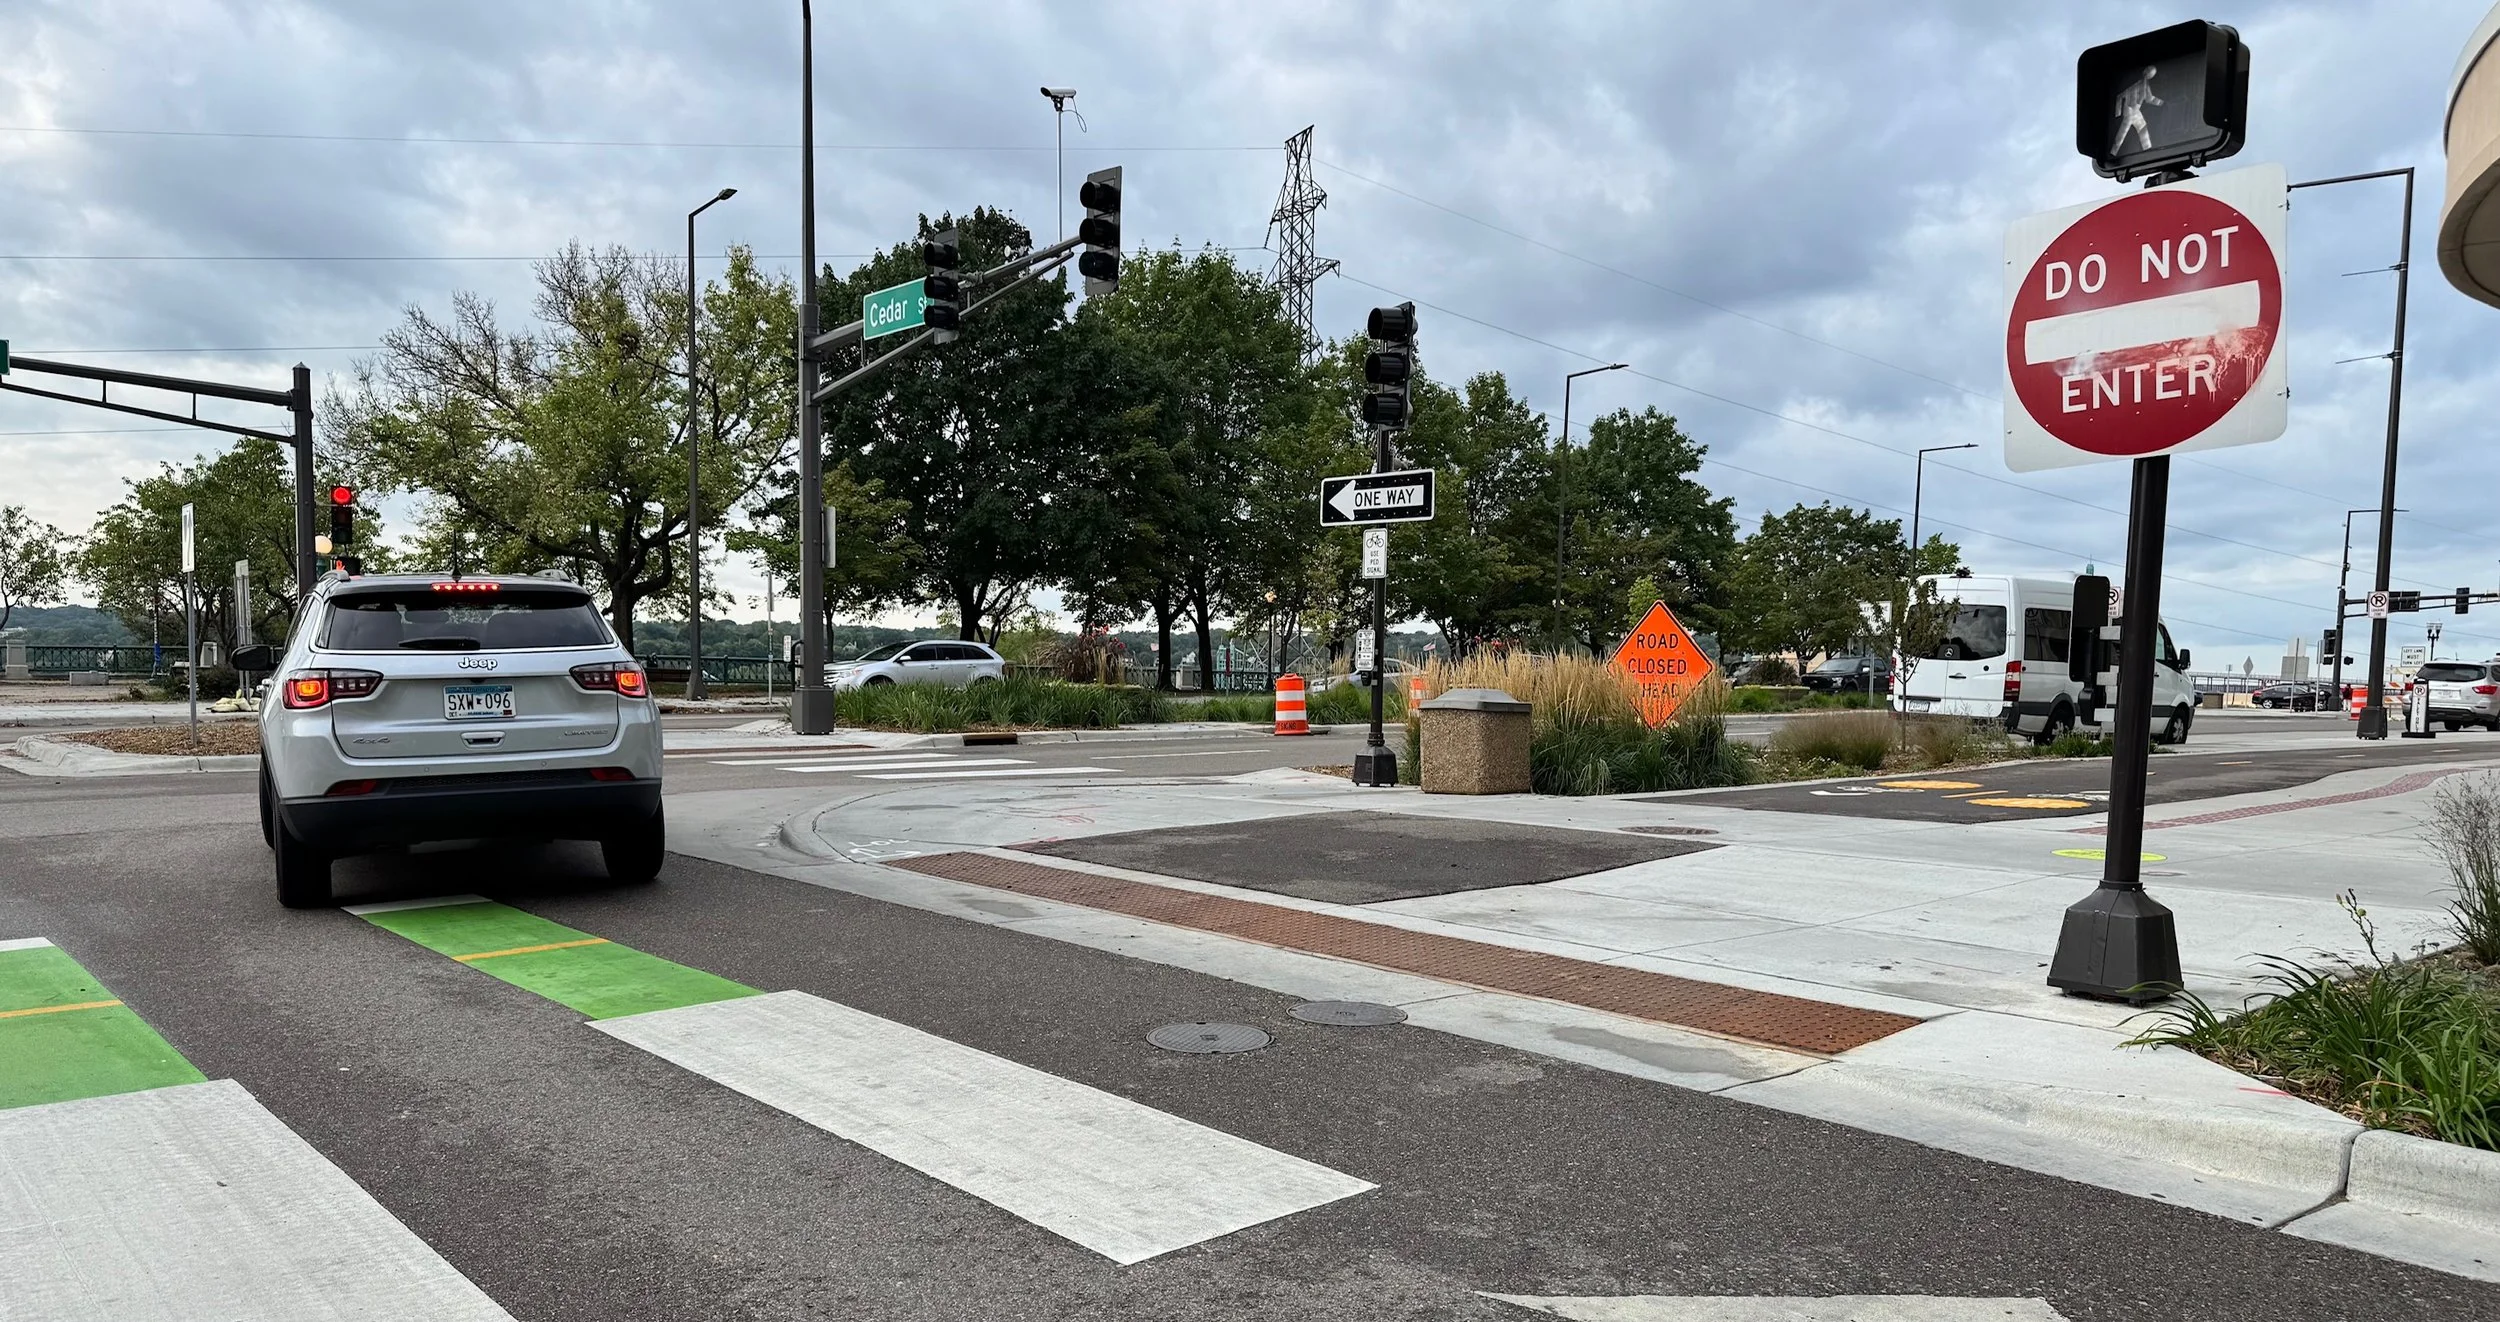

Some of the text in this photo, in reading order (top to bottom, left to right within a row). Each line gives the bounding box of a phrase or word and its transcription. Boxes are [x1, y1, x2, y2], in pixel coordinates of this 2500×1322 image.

[2046, 226, 2239, 300] DO NOT
[870, 298, 908, 328] Cedar
[2062, 354, 2217, 413] ENTER
[1355, 488, 1414, 507] ONE WAY
[1637, 633, 1679, 649] ROAD
[458, 657, 498, 671] Jeep
[1628, 658, 1687, 675] CLOSED
[448, 693, 511, 711] SXW 096
